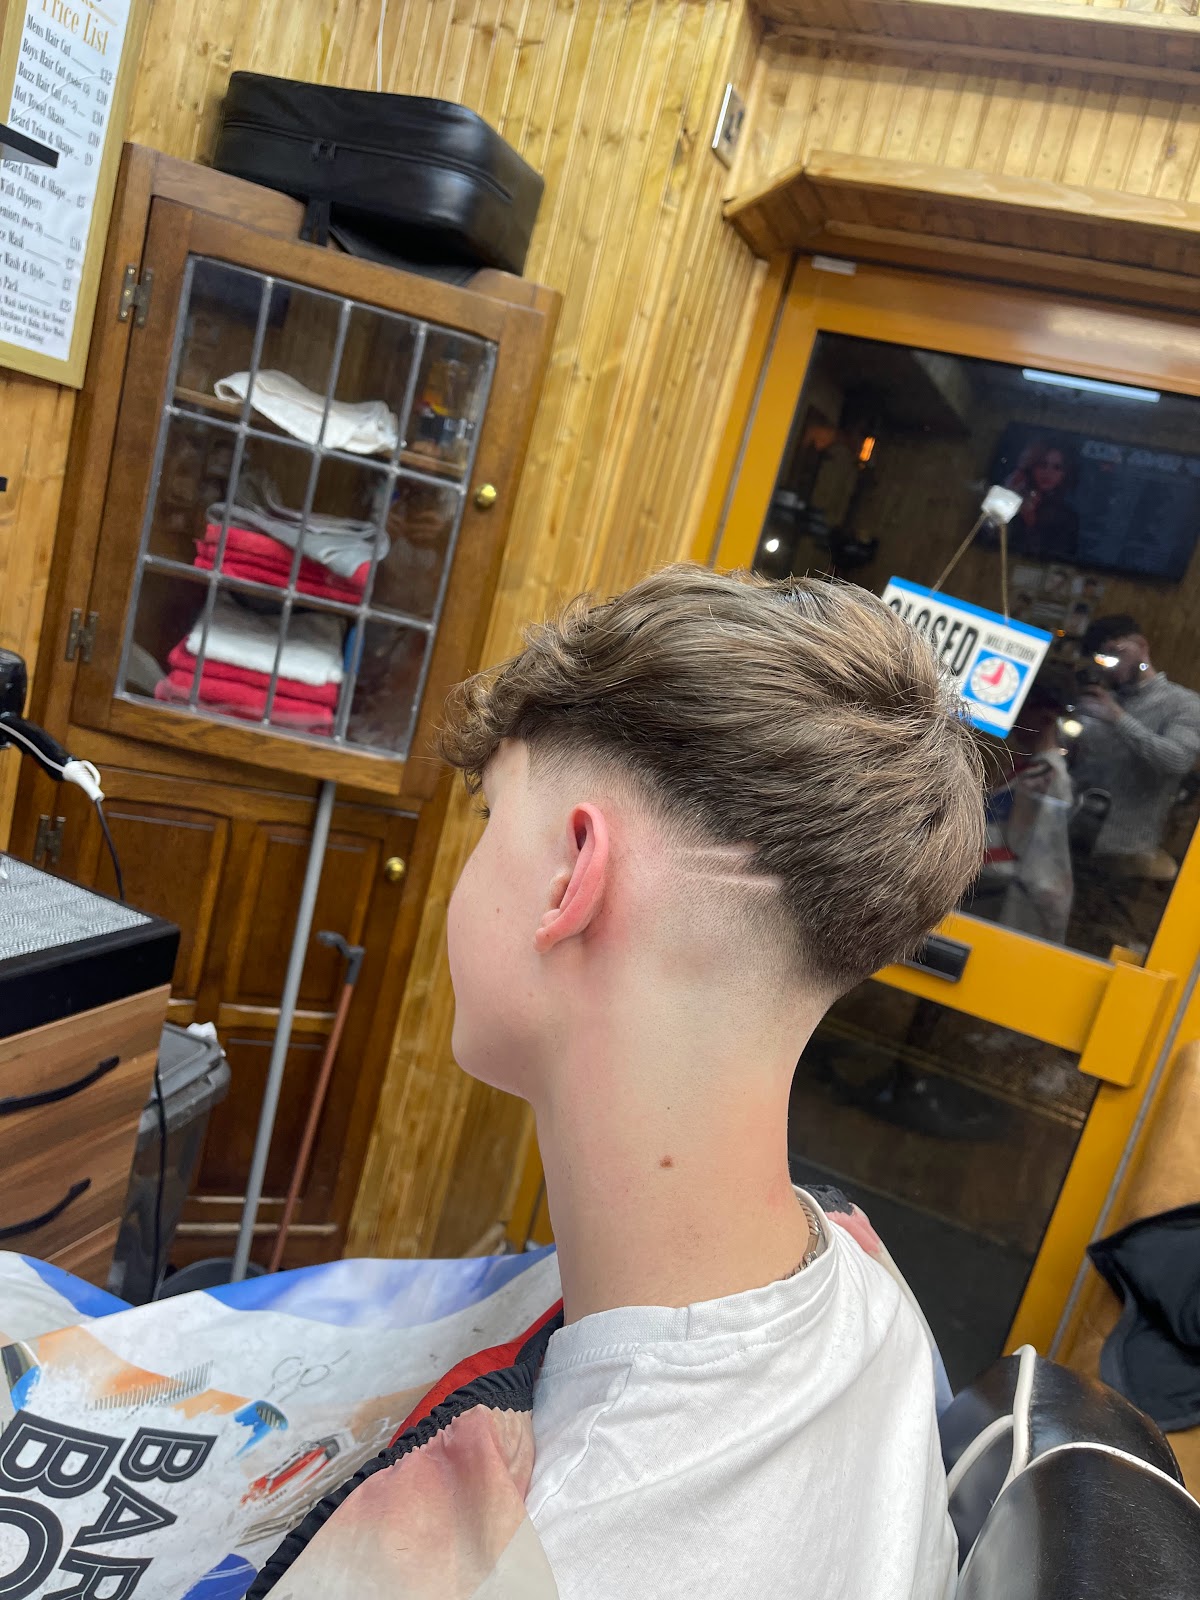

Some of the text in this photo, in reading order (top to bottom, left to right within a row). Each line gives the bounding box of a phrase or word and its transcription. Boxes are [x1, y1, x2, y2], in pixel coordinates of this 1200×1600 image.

[27, 14, 44, 38] Mens
[45, 27, 60, 49] Hair
[60, 38, 72, 57] Cut
[83, 12, 109, 56] List
[22, 38, 39, 61] Boys
[40, 49, 54, 71] Hair
[55, 60, 66, 79] Cut
[14, 84, 28, 105] Hot
[28, 92, 47, 116] Towel
[18, 61, 35, 84] Buzz
[36, 73, 50, 94] Hair
[51, 83, 62, 101] Cut
[11, 108, 30, 132] Beard
[31, 120, 47, 141] Trim
[24, 165, 40, 185] Trim
